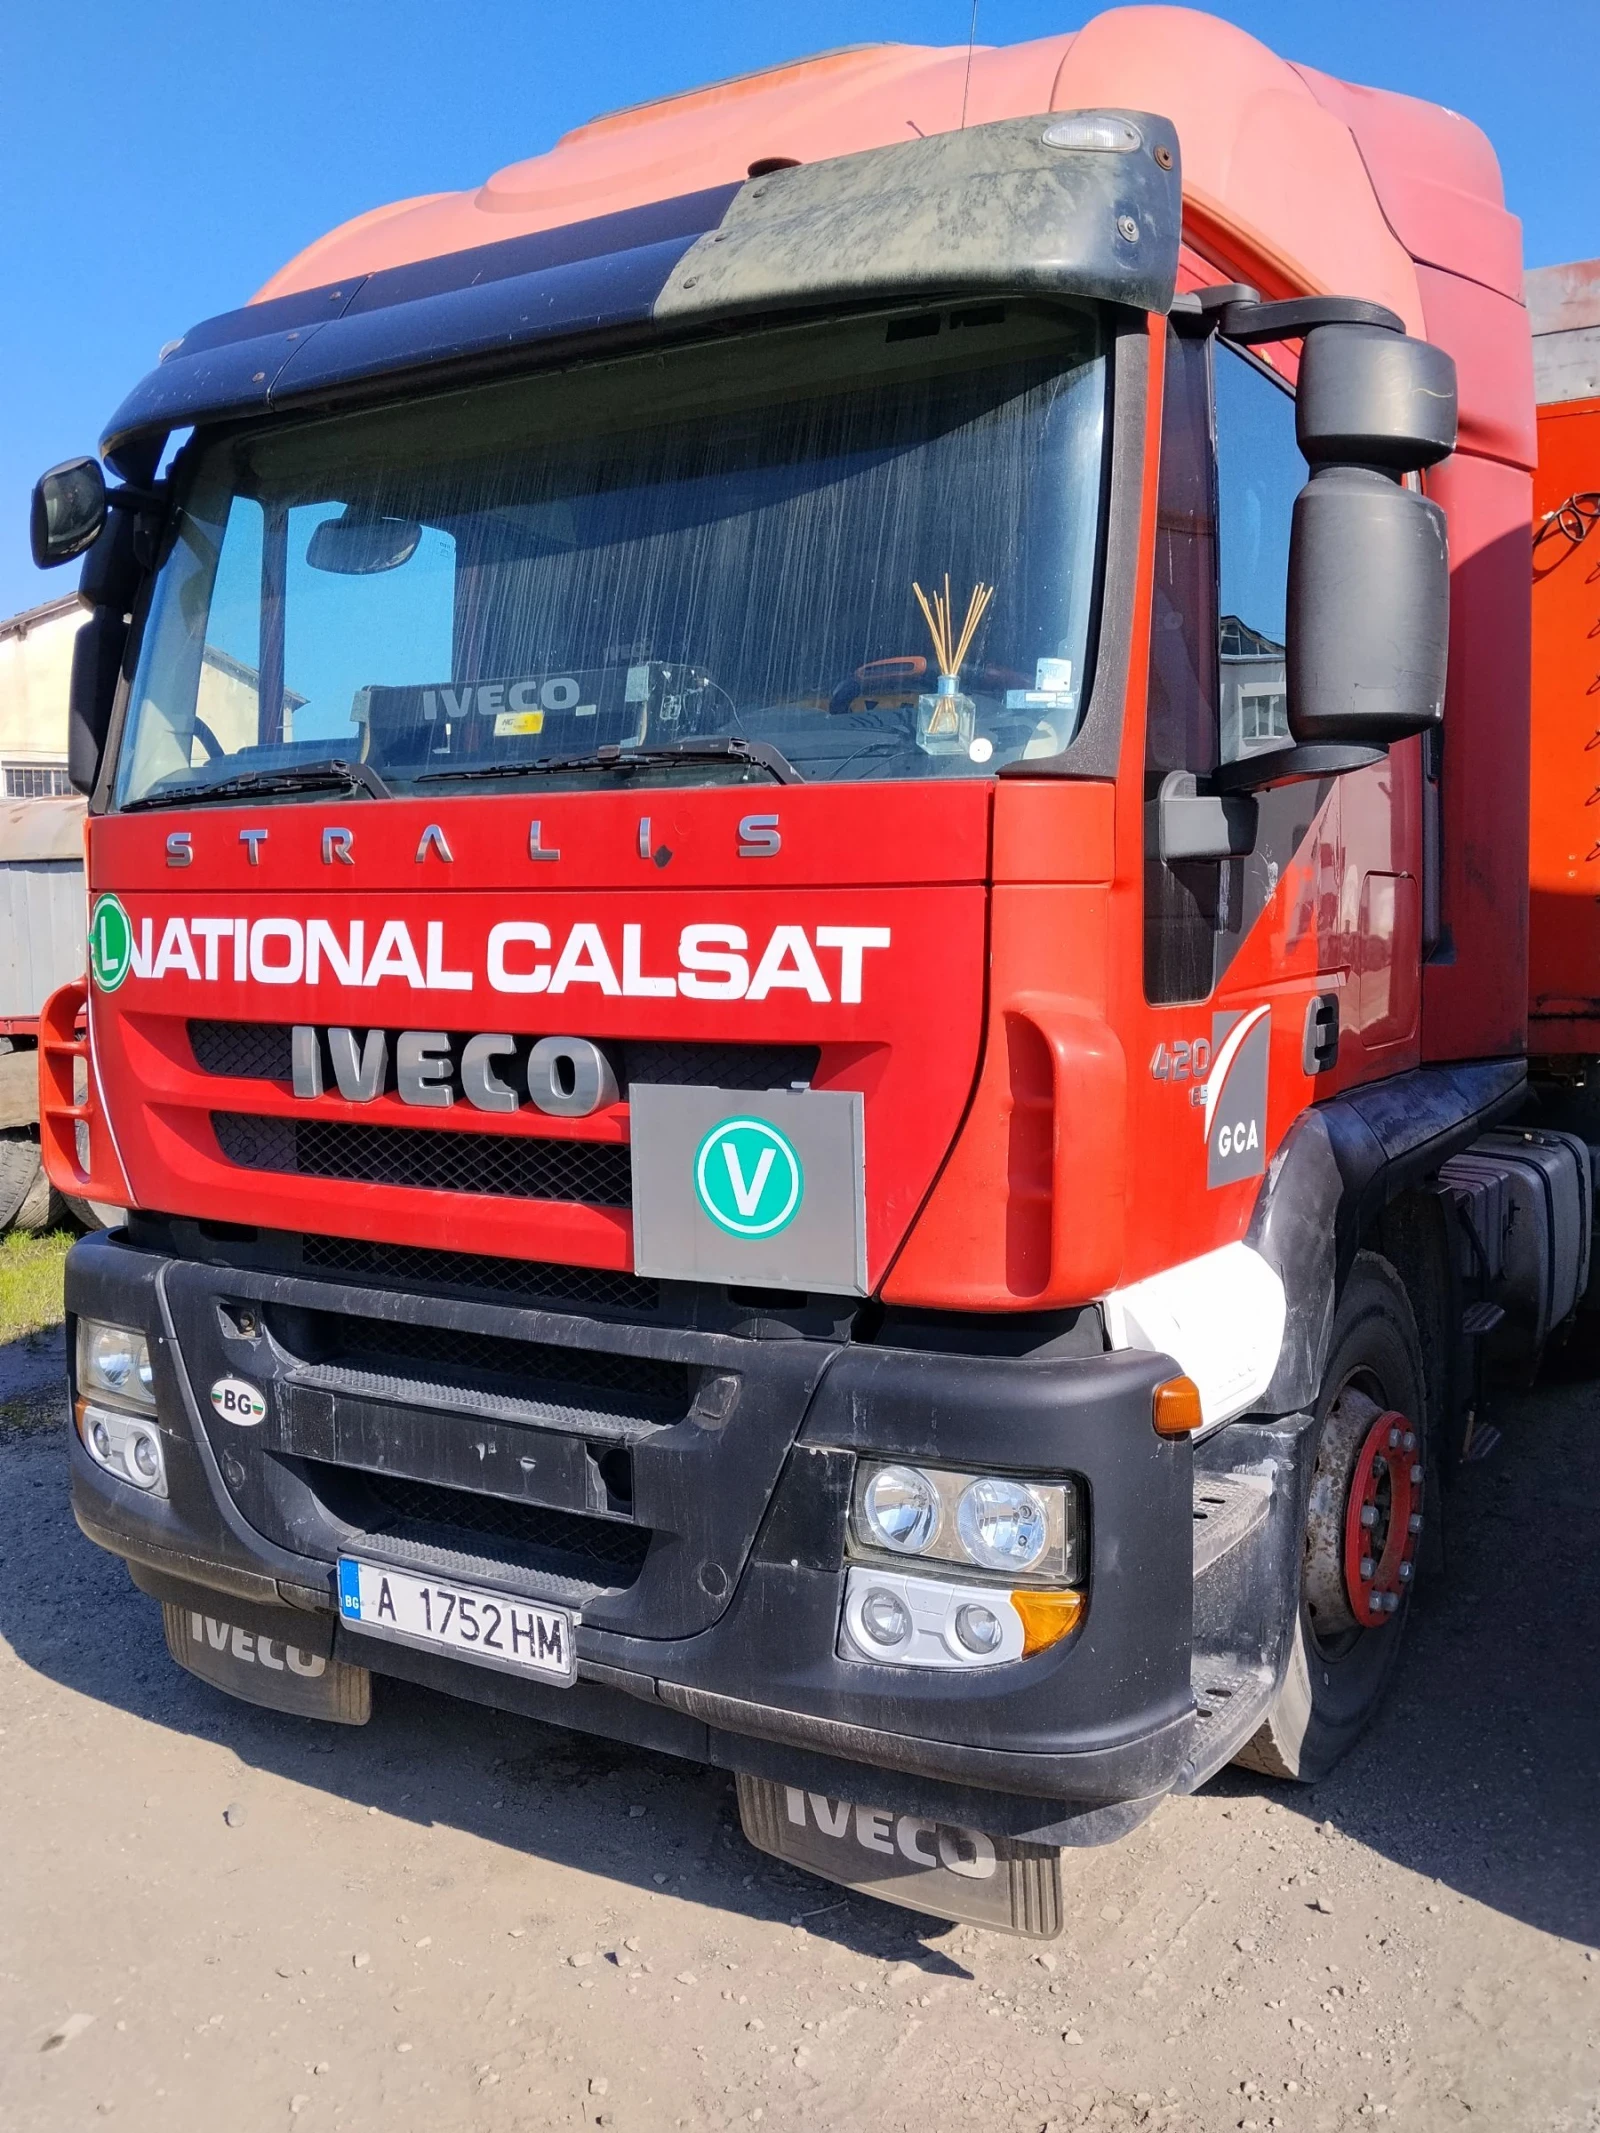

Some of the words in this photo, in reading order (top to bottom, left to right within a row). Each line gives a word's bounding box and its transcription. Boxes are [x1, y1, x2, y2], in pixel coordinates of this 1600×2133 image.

[423, 678, 580, 720] IVECO
[100, 916, 119, 971] L
[130, 917, 473, 991] NATIONAL
[487, 921, 891, 1004] CALSAT
[291, 1025, 620, 1117] IVECO
[1150, 1038, 1211, 1083] 420
[1218, 1119, 1259, 1157] GCA
[721, 1142, 777, 1217] V
[224, 1389, 251, 1416] BG
[345, 1595, 360, 1609] BG
[377, 1577, 397, 1622] A
[784, 1785, 996, 1880] IVECO
